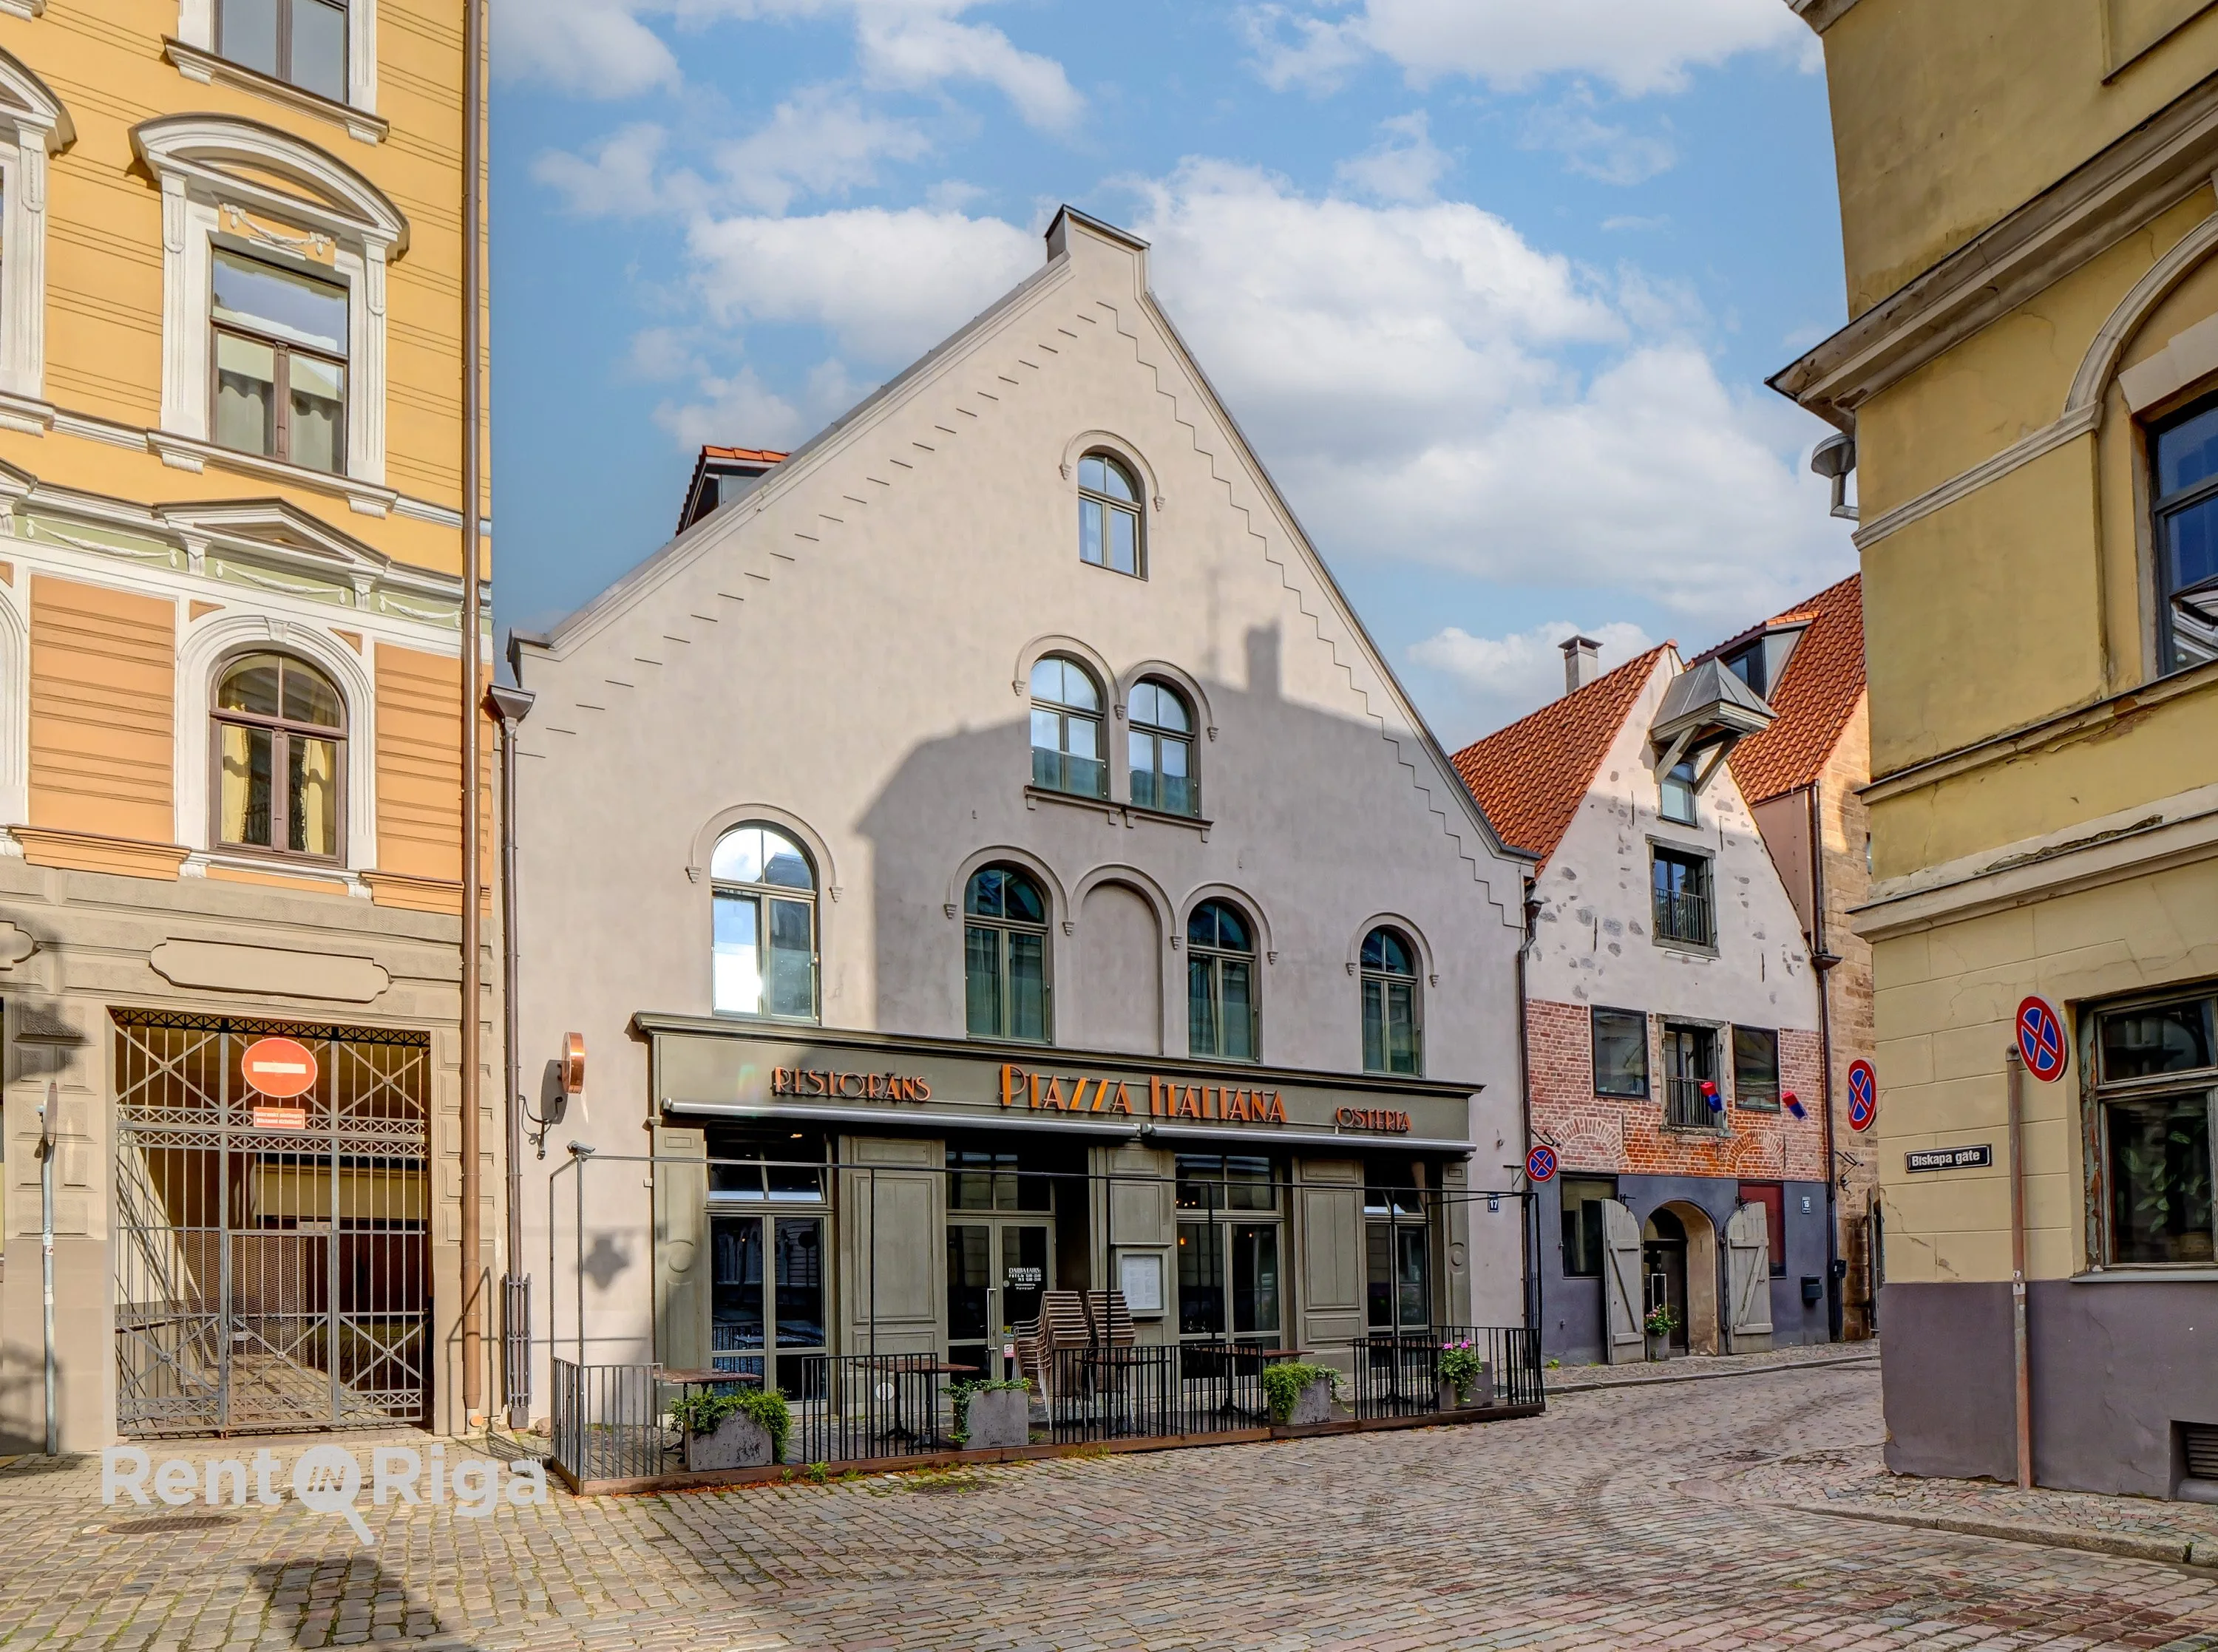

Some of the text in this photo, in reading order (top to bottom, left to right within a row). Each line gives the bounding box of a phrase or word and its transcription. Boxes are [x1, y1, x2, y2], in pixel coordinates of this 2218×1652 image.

[1000, 1064, 1287, 1124] PIAZZA ITALIANA
[1336, 1107, 1413, 1132] OSTERIA
[1490, 1200, 1498, 1209] 17
